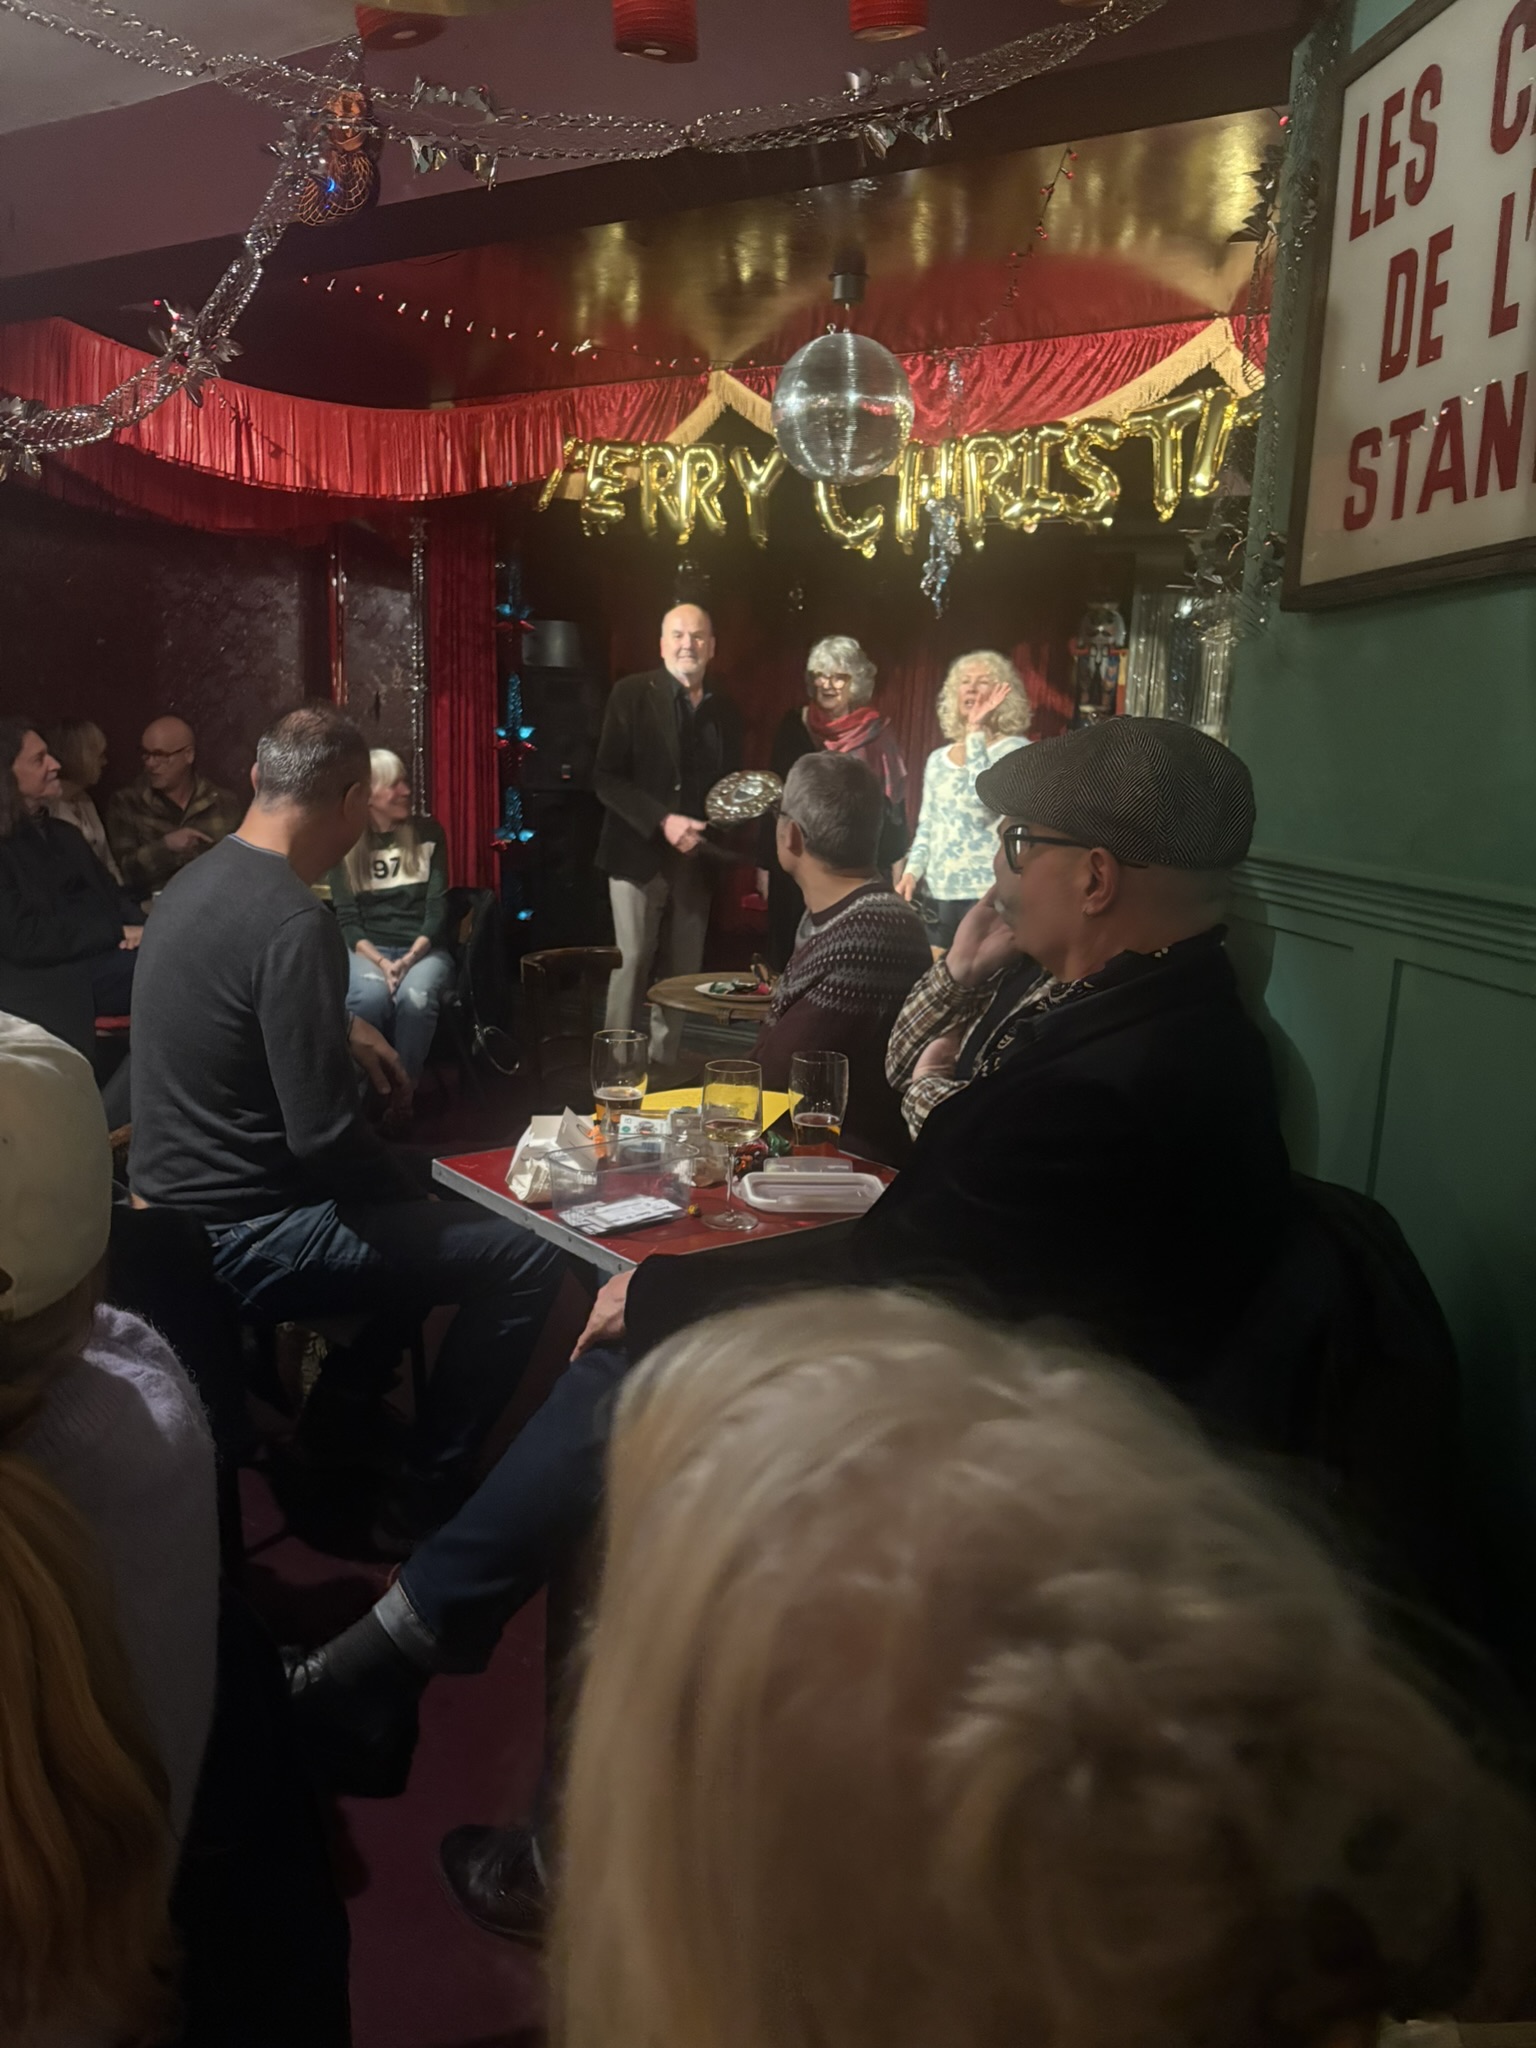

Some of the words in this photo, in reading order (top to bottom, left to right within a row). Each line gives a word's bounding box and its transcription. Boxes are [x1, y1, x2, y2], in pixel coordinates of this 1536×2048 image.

[1350, 64, 1443, 241] LES
[1490, 0, 1536, 154] C
[1379, 225, 1454, 383] DE
[1343, 371, 1536, 532] STAN
